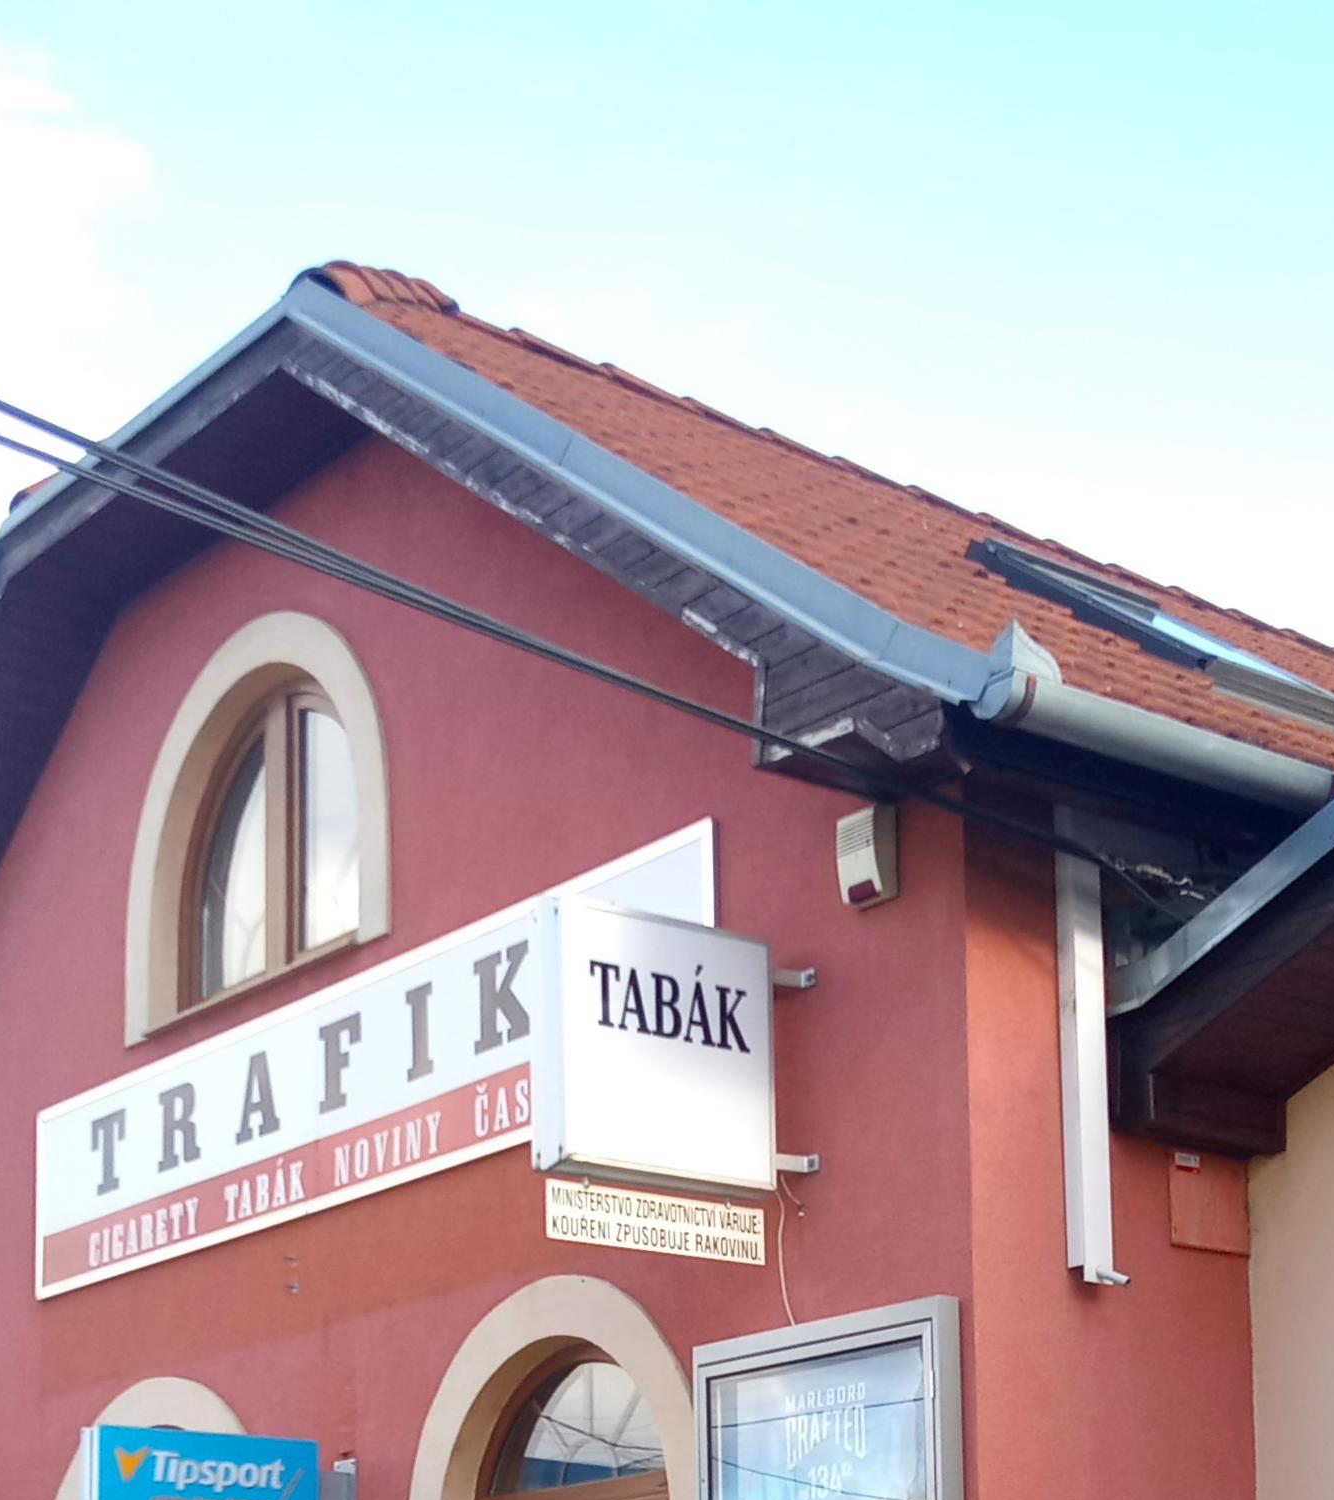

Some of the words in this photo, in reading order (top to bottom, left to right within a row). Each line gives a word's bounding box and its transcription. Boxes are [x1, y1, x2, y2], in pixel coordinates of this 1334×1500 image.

[590, 960, 750, 1053] TABÁK
[91, 939, 529, 1196] TRAFIK
[89, 1198, 199, 1267] CIGARETY
[224, 1158, 305, 1222] TABÁK
[334, 1111, 441, 1187] NOVINY
[551, 1187, 631, 1217] MINISTERSTVO
[636, 1198, 717, 1228] ZDRAVOTNICTVÍ
[695, 1234, 762, 1261] RAKOVINU.
[786, 1382, 865, 1412] MARLBORO
[786, 1403, 867, 1471] CRAFTED
[152, 1450, 285, 1493] Tipsport
